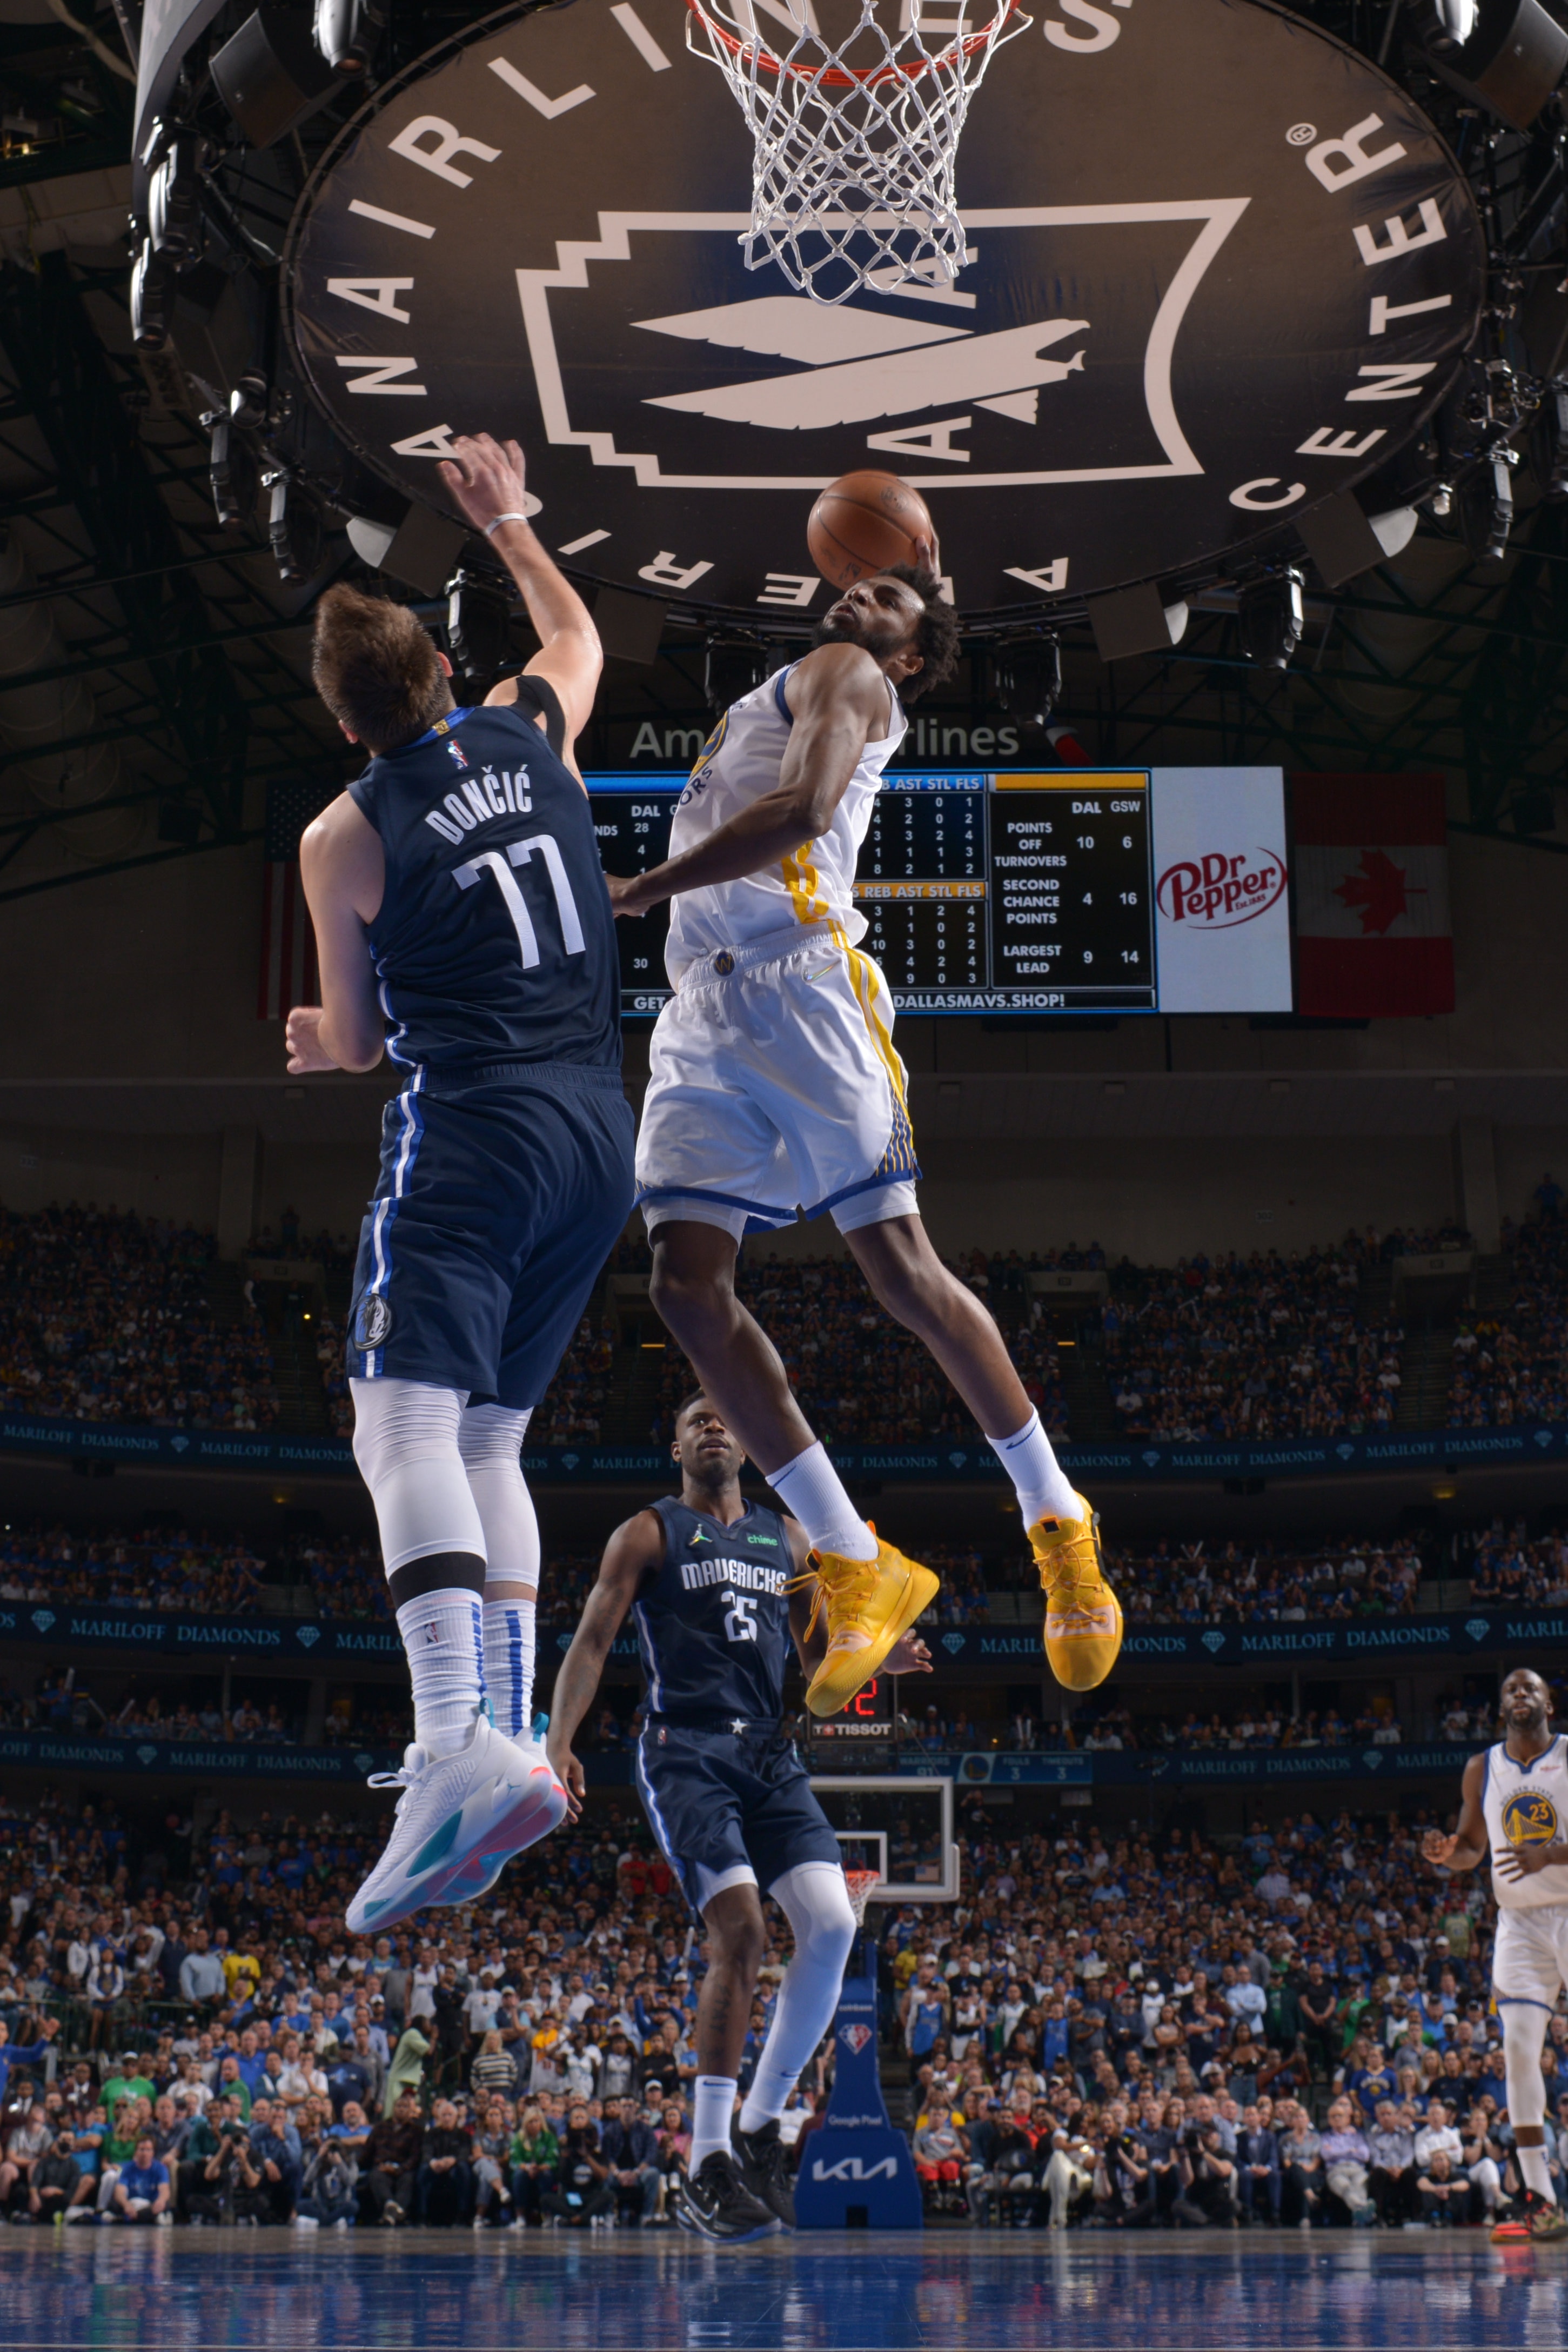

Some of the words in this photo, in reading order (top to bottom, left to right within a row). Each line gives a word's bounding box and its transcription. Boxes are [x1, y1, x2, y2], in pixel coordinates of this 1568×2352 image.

[336, 356, 1069, 607] AERIAN
[897, 718, 1020, 756] rlines
[895, 778, 922, 790] AST
[927, 778, 950, 789] STL
[956, 778, 979, 789] FLS
[424, 764, 533, 846] DONČIĆ
[906, 798, 912, 807] 3
[936, 798, 942, 806] 0
[967, 798, 971, 806] 1
[1073, 803, 1101, 813] DAL
[1111, 801, 1140, 812] GSW
[631, 805, 660, 817] DAL
[874, 815, 881, 823] 4
[906, 814, 912, 824] 2
[936, 814, 942, 823] 0
[966, 814, 971, 823] 2
[634, 823, 649, 833] 28
[1008, 823, 1052, 833] POINTS
[875, 831, 880, 840] 3
[906, 831, 912, 840] 3
[937, 831, 943, 840] 2
[966, 831, 973, 839] 4
[638, 845, 645, 854] 4
[1019, 840, 1041, 849] OFF
[1077, 837, 1094, 848] 10
[1123, 837, 1131, 848] 6
[876, 848, 880, 857] 1
[907, 847, 912, 857] 1
[938, 847, 943, 856] 1
[967, 847, 973, 856] 3
[995, 856, 1066, 866] TURNOVERS
[875, 865, 881, 873] 8
[906, 864, 912, 873] 2
[939, 864, 943, 873] 1
[967, 864, 973, 873] 2
[1201, 853, 1246, 888] Dr
[865, 886, 891, 897] REB
[896, 885, 923, 897] AST
[929, 885, 952, 897] STL
[957, 885, 981, 896] FLS
[1004, 880, 1059, 890] SECOND
[1157, 862, 1276, 923] Pepper
[451, 834, 586, 970] 77
[1004, 897, 1059, 907] CHANCE
[1083, 893, 1092, 904] 4
[1120, 893, 1137, 904] 16
[875, 906, 881, 916] 3
[908, 906, 913, 915] 1
[938, 906, 944, 915] 2
[968, 906, 975, 914] 4
[1007, 913, 1056, 924] POINTS
[875, 924, 881, 932] 6
[908, 923, 913, 932] 1
[938, 923, 944, 932] 0
[968, 923, 974, 932] 2
[872, 940, 885, 950] 10
[907, 940, 914, 949] 3
[938, 940, 944, 949] 0
[969, 939, 975, 949] 2
[1004, 946, 1061, 955] LARGEST
[1084, 951, 1092, 963] 9
[1122, 951, 1138, 963] 14
[633, 959, 648, 968] 30
[907, 957, 914, 966] 4
[939, 957, 944, 966] 2
[968, 957, 975, 965] 4
[1017, 963, 1049, 972] LEAD
[907, 974, 914, 983] 9
[939, 974, 945, 983] 0
[969, 973, 975, 983] 3
[634, 997, 665, 1010] GET
[894, 993, 1064, 1008] DALLASMAVS.SHOP!
[4, 1424, 73, 1444] MARILOFF
[82, 1432, 159, 1451] DIAMONDS
[201, 1441, 271, 1458] MARILOFF
[1366, 1442, 1436, 1458] MARILOFF
[1445, 1436, 1523, 1453] DIAMONDS
[593, 1458, 660, 1469] MARILOFF
[863, 1456, 938, 1469] DIAMONDS
[1172, 1454, 1240, 1467] MARILOFF
[1249, 1451, 1325, 1466] DIAMONDS
[747, 1533, 778, 1546] chime
[681, 1559, 787, 1596] MAVERICKS
[721, 1590, 757, 1642] 25
[71, 1620, 166, 1640] MARILOFF
[177, 1626, 281, 1646] DIAMONDS
[1242, 1633, 1336, 1652] MARILOFF
[1346, 1627, 1450, 1647] DIAMONDS
[833, 1723, 890, 1736] TISSOT
[40, 1743, 123, 1762] DIAMONDS
[170, 1752, 247, 1768] MARILOFF
[257, 1754, 342, 1771] DIAMONDS
[1181, 1759, 1258, 1775] MARILOFF
[1267, 1757, 1351, 1774] DIAMONDS
[1011, 1767, 1020, 1780] 3
[1057, 1767, 1067, 1780] 3
[1530, 1802, 1550, 1821] 23
